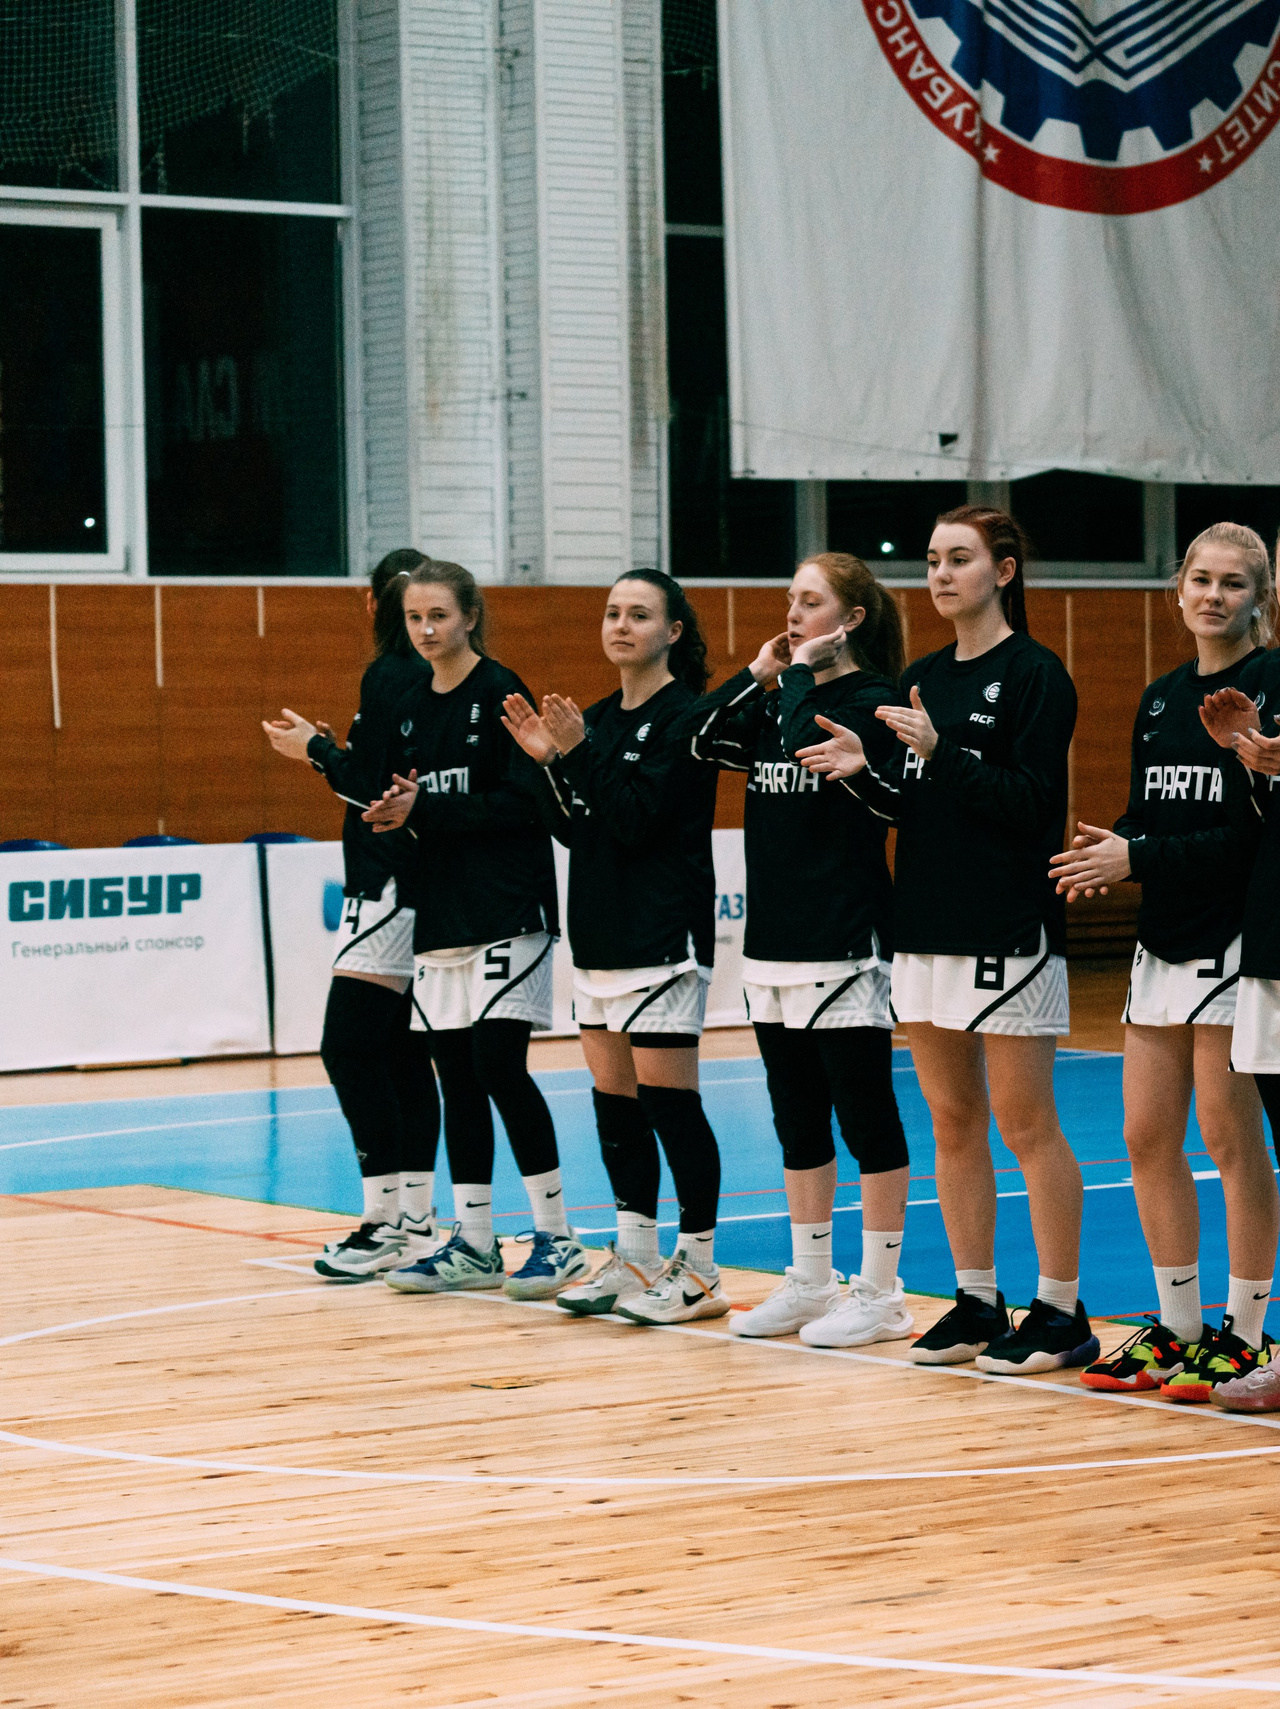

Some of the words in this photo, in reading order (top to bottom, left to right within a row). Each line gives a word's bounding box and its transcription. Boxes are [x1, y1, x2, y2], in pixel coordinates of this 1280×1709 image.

[1145, 765, 1223, 802] PARTA
[8, 873, 202, 922] СИБУР
[11, 936, 130, 960] Генеральный
[134, 935, 206, 952] спонсор
[484, 940, 512, 981] 5
[974, 955, 1005, 991] 8
